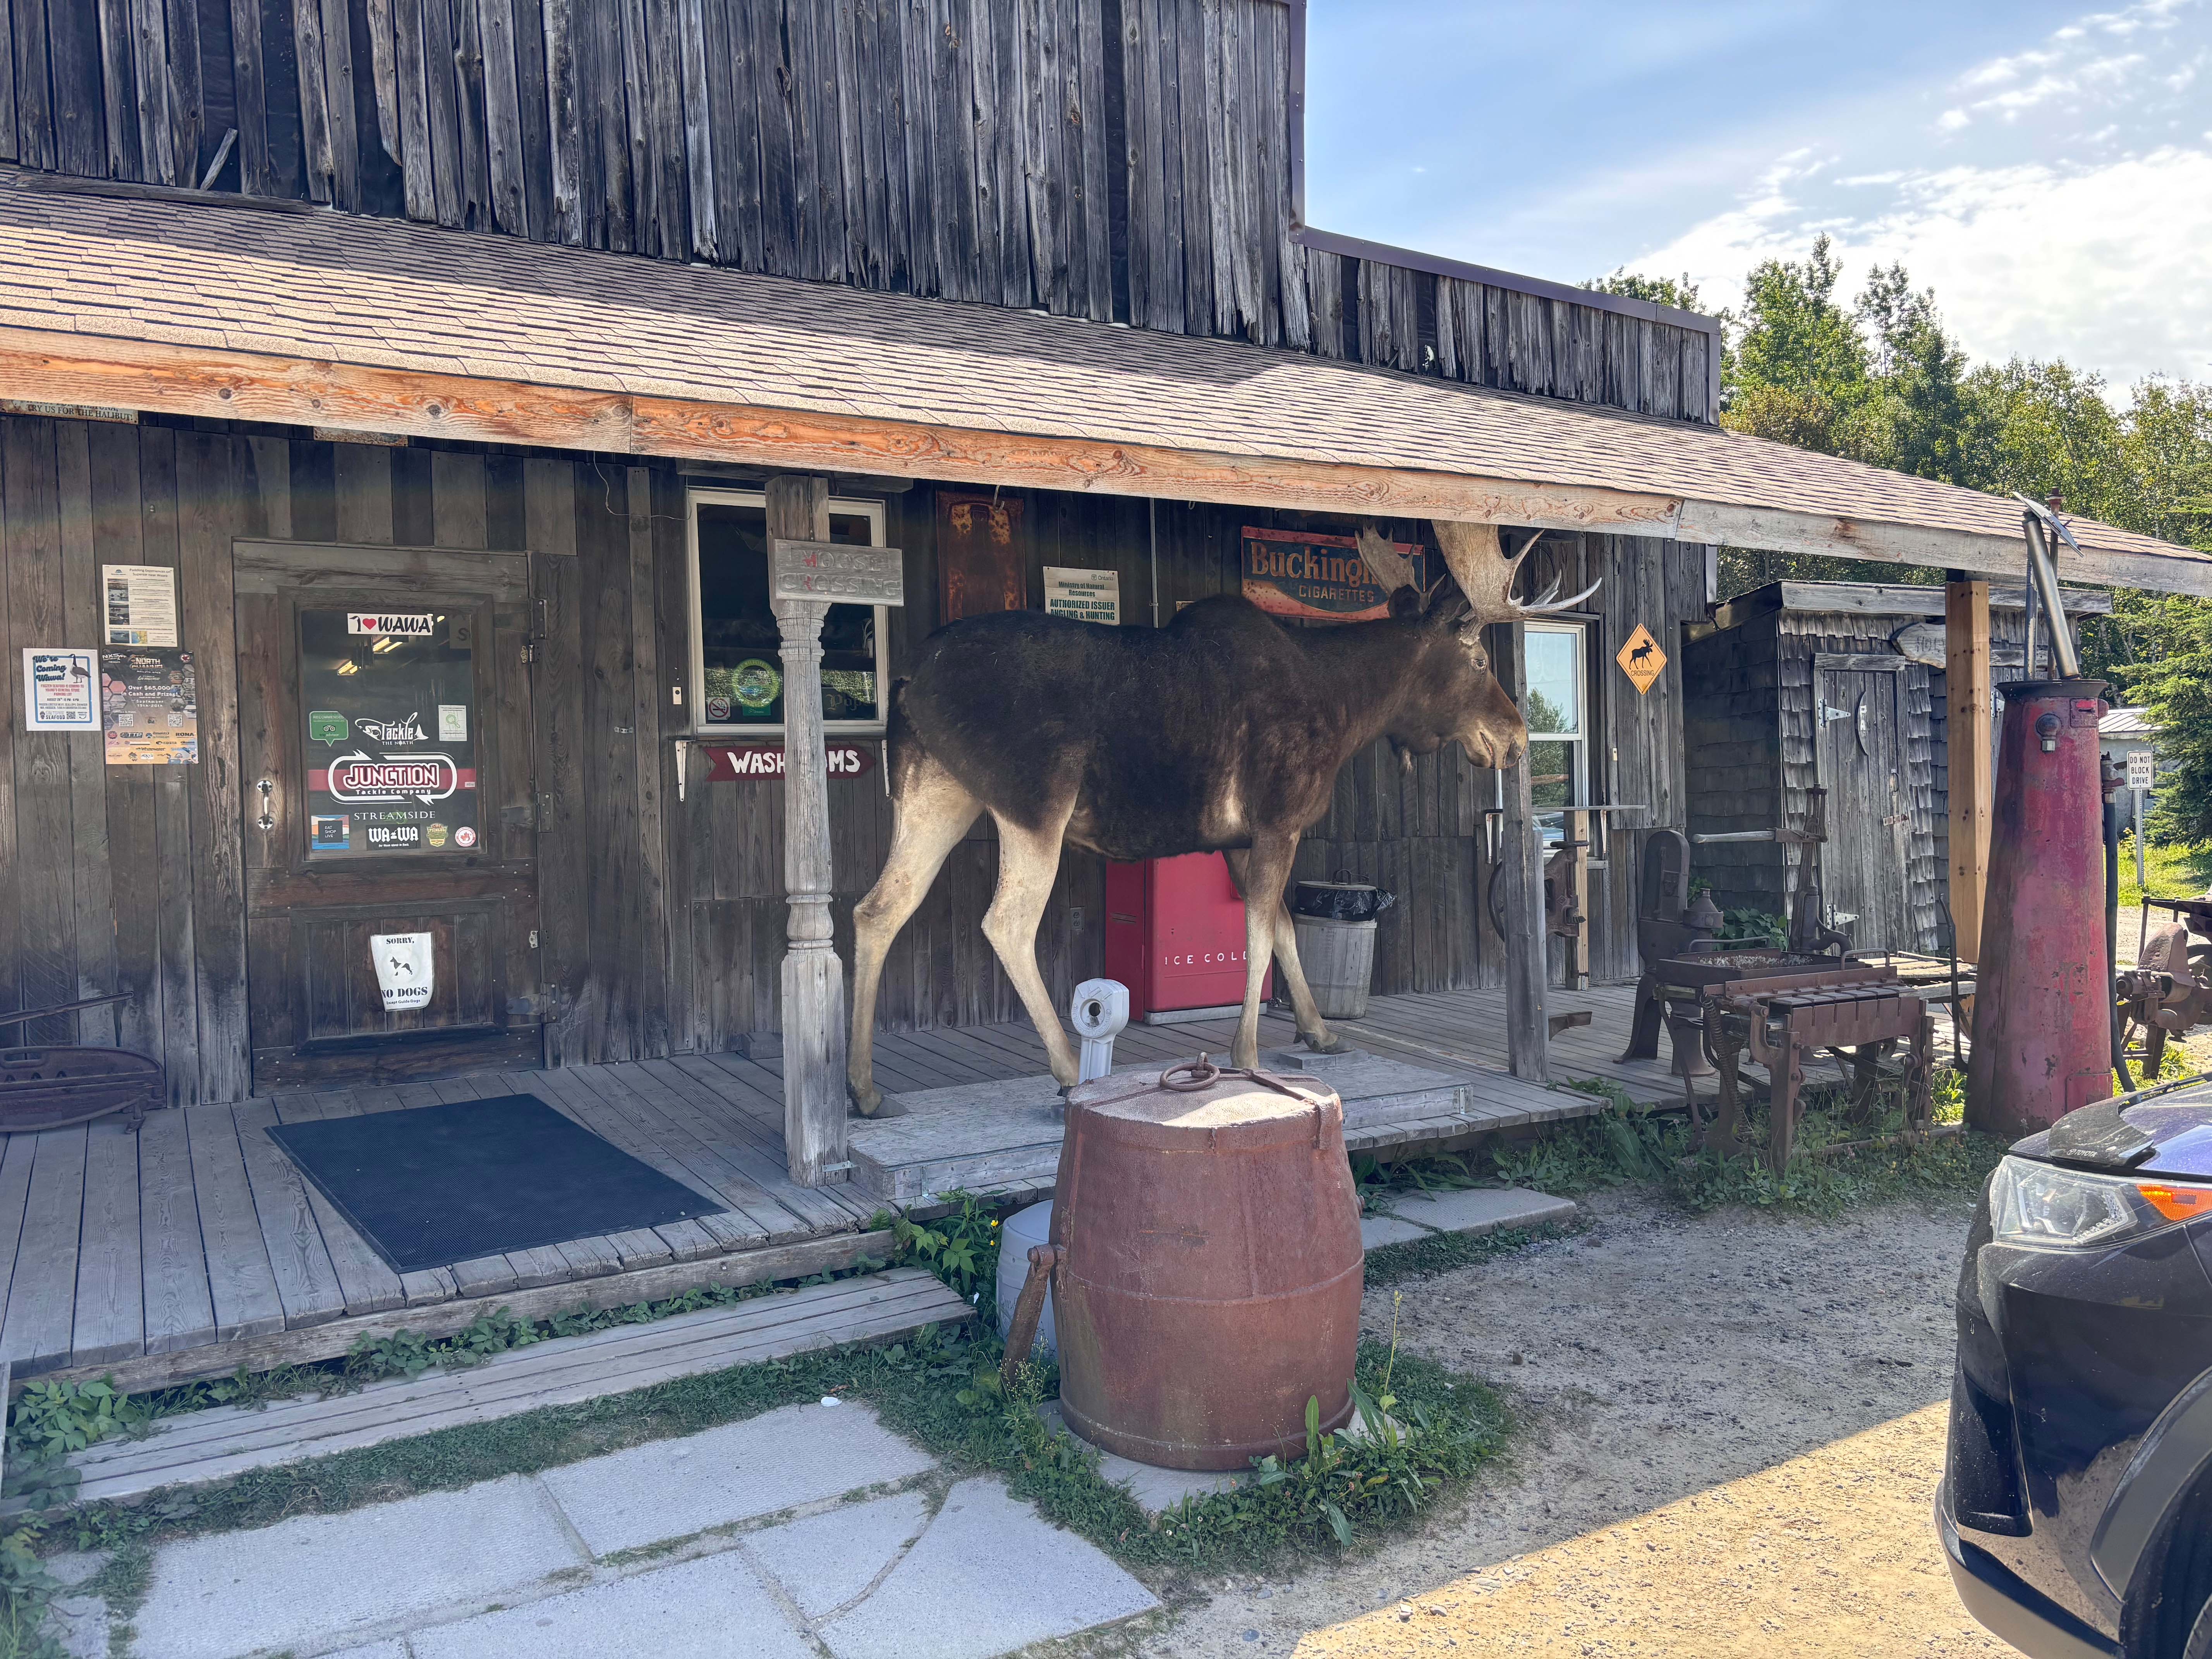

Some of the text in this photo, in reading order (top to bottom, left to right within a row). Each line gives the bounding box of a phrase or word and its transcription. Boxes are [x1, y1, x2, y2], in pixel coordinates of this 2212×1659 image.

[95, 410, 133, 421] HALIBUT!
[799, 549, 882, 571] MOOSE
[1250, 541, 1378, 588] Bucking
[781, 573, 901, 596] CROSSING
[1299, 584, 1375, 603] CIGARETTES
[1050, 599, 1115, 610] AUTHORIZED ISSUER
[1050, 609, 1078, 619] ANGLING
[1085, 611, 1115, 620] HUNTING
[378, 616, 431, 633] WAWA
[33, 655, 59, 663] We're
[36, 664, 67, 673] Coming
[36, 673, 65, 682] Wawa!
[381, 712, 418, 740] Tackle
[726, 749, 860, 774] WASHMS
[345, 764, 438, 786] JUNCTION
[354, 811, 436, 820] STREAMSIDE
[368, 827, 390, 843] WA
[397, 826, 419, 841] WA
[1164, 955, 1194, 965] ICE
[381, 987, 428, 998] NO DOGS
